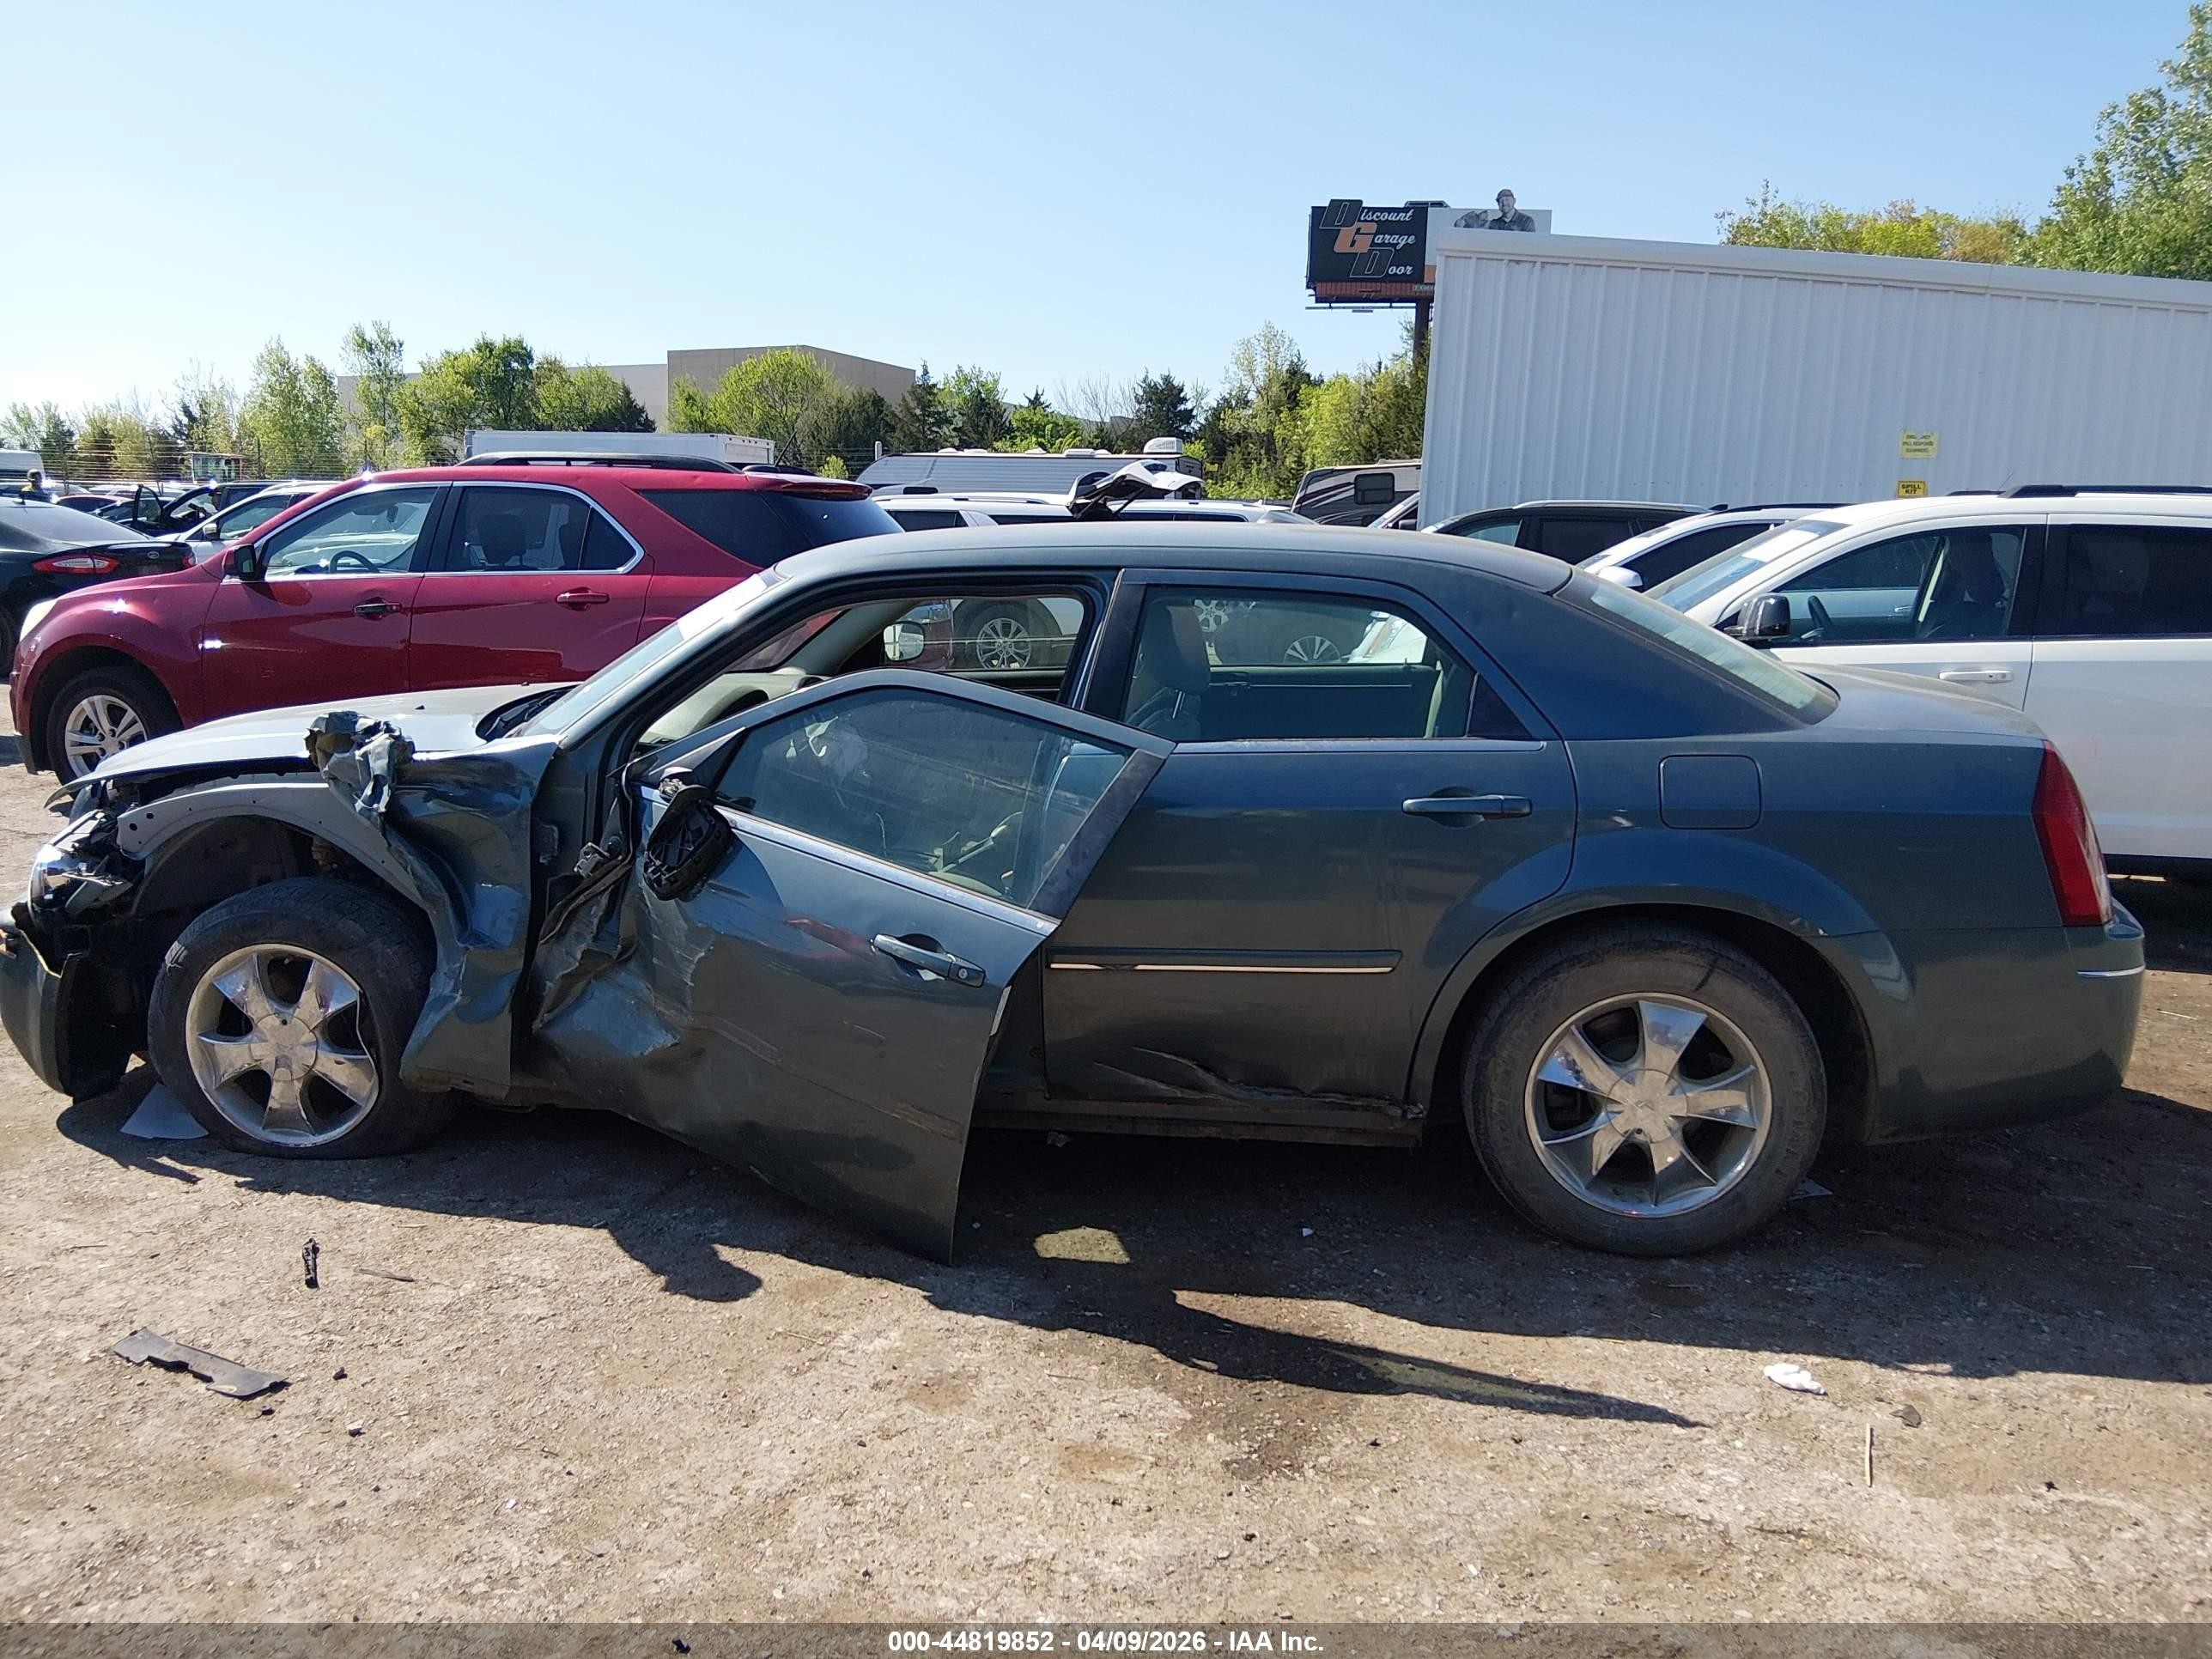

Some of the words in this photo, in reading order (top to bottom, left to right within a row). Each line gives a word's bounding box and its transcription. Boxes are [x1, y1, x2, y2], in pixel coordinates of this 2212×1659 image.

[1319, 198, 1414, 229] Discount
[1334, 222, 1416, 253] Garage
[1349, 246, 1413, 278] Door
